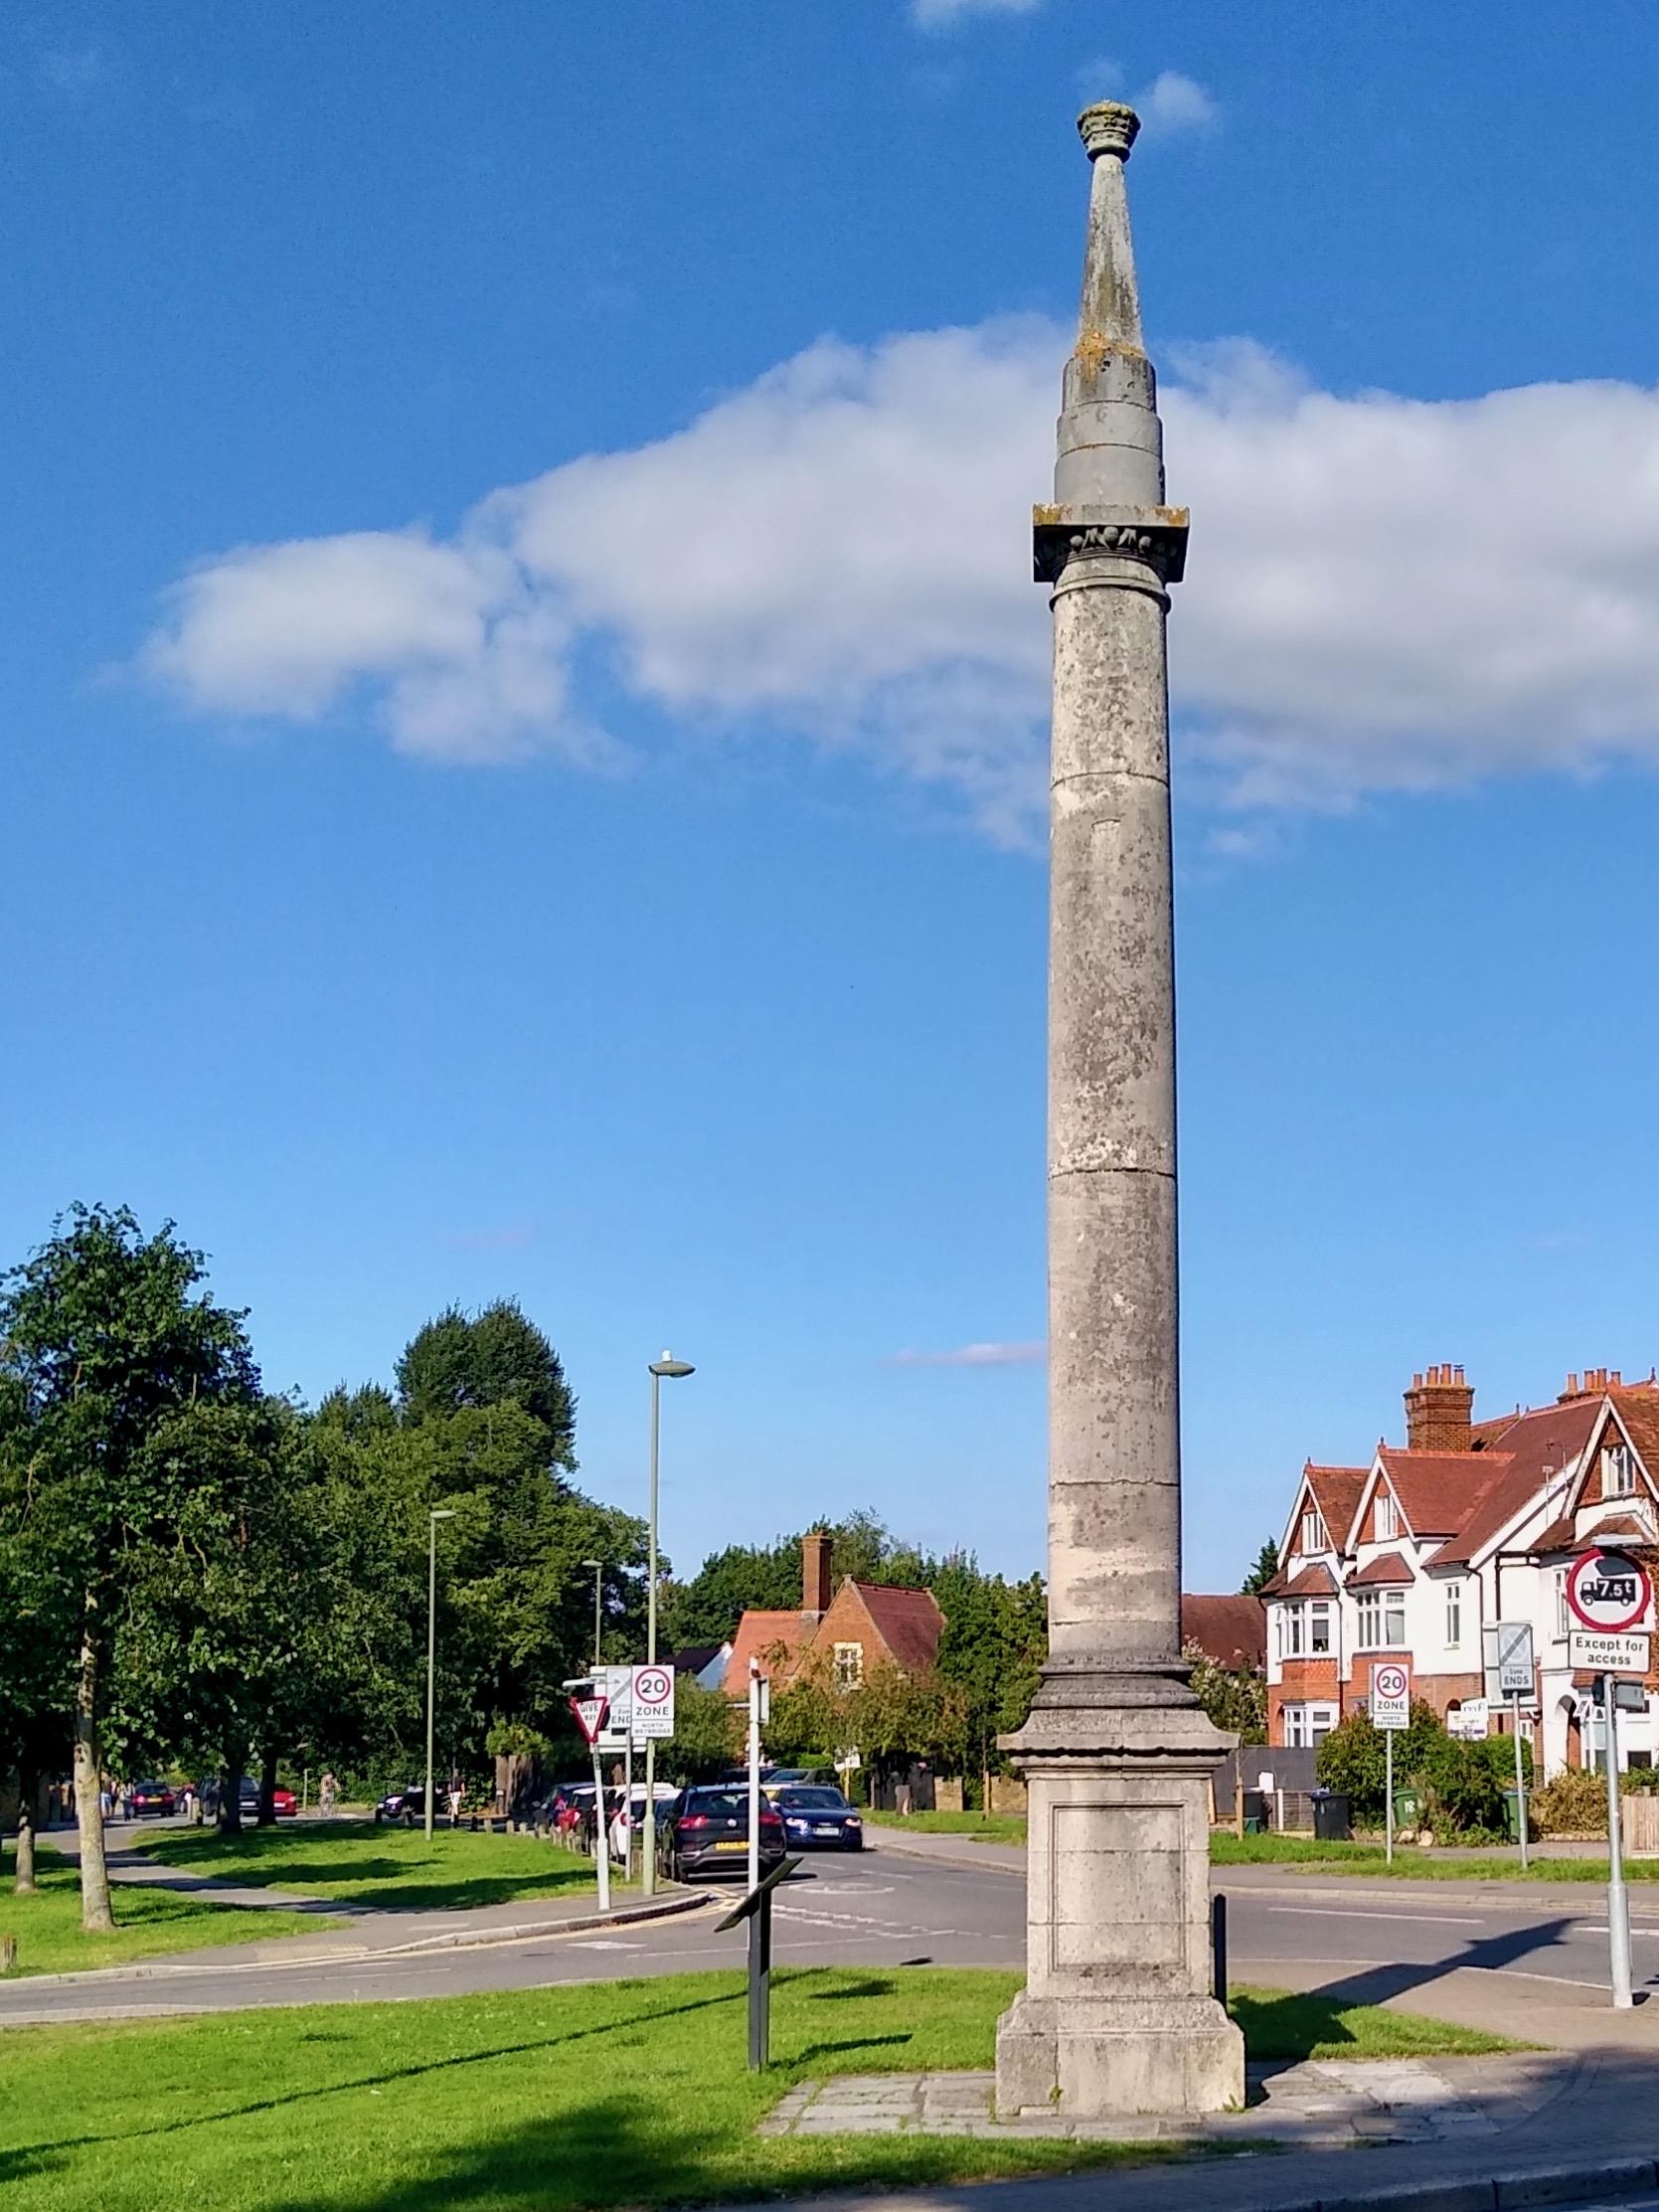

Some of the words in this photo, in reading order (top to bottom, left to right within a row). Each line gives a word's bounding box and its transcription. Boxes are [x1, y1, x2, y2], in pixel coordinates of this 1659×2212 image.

[1576, 1636, 1621, 1651] Except
[1625, 1639, 1643, 1651] for
[1587, 1654, 1631, 1665] access
[1382, 1675, 1402, 1689] 20
[1504, 1675, 1529, 1685] ENDS
[641, 1679, 666, 1693] 20
[580, 1701, 598, 1712] GIVE
[1377, 1700, 1405, 1710] ZONE
[635, 1706, 669, 1716] ZONE
